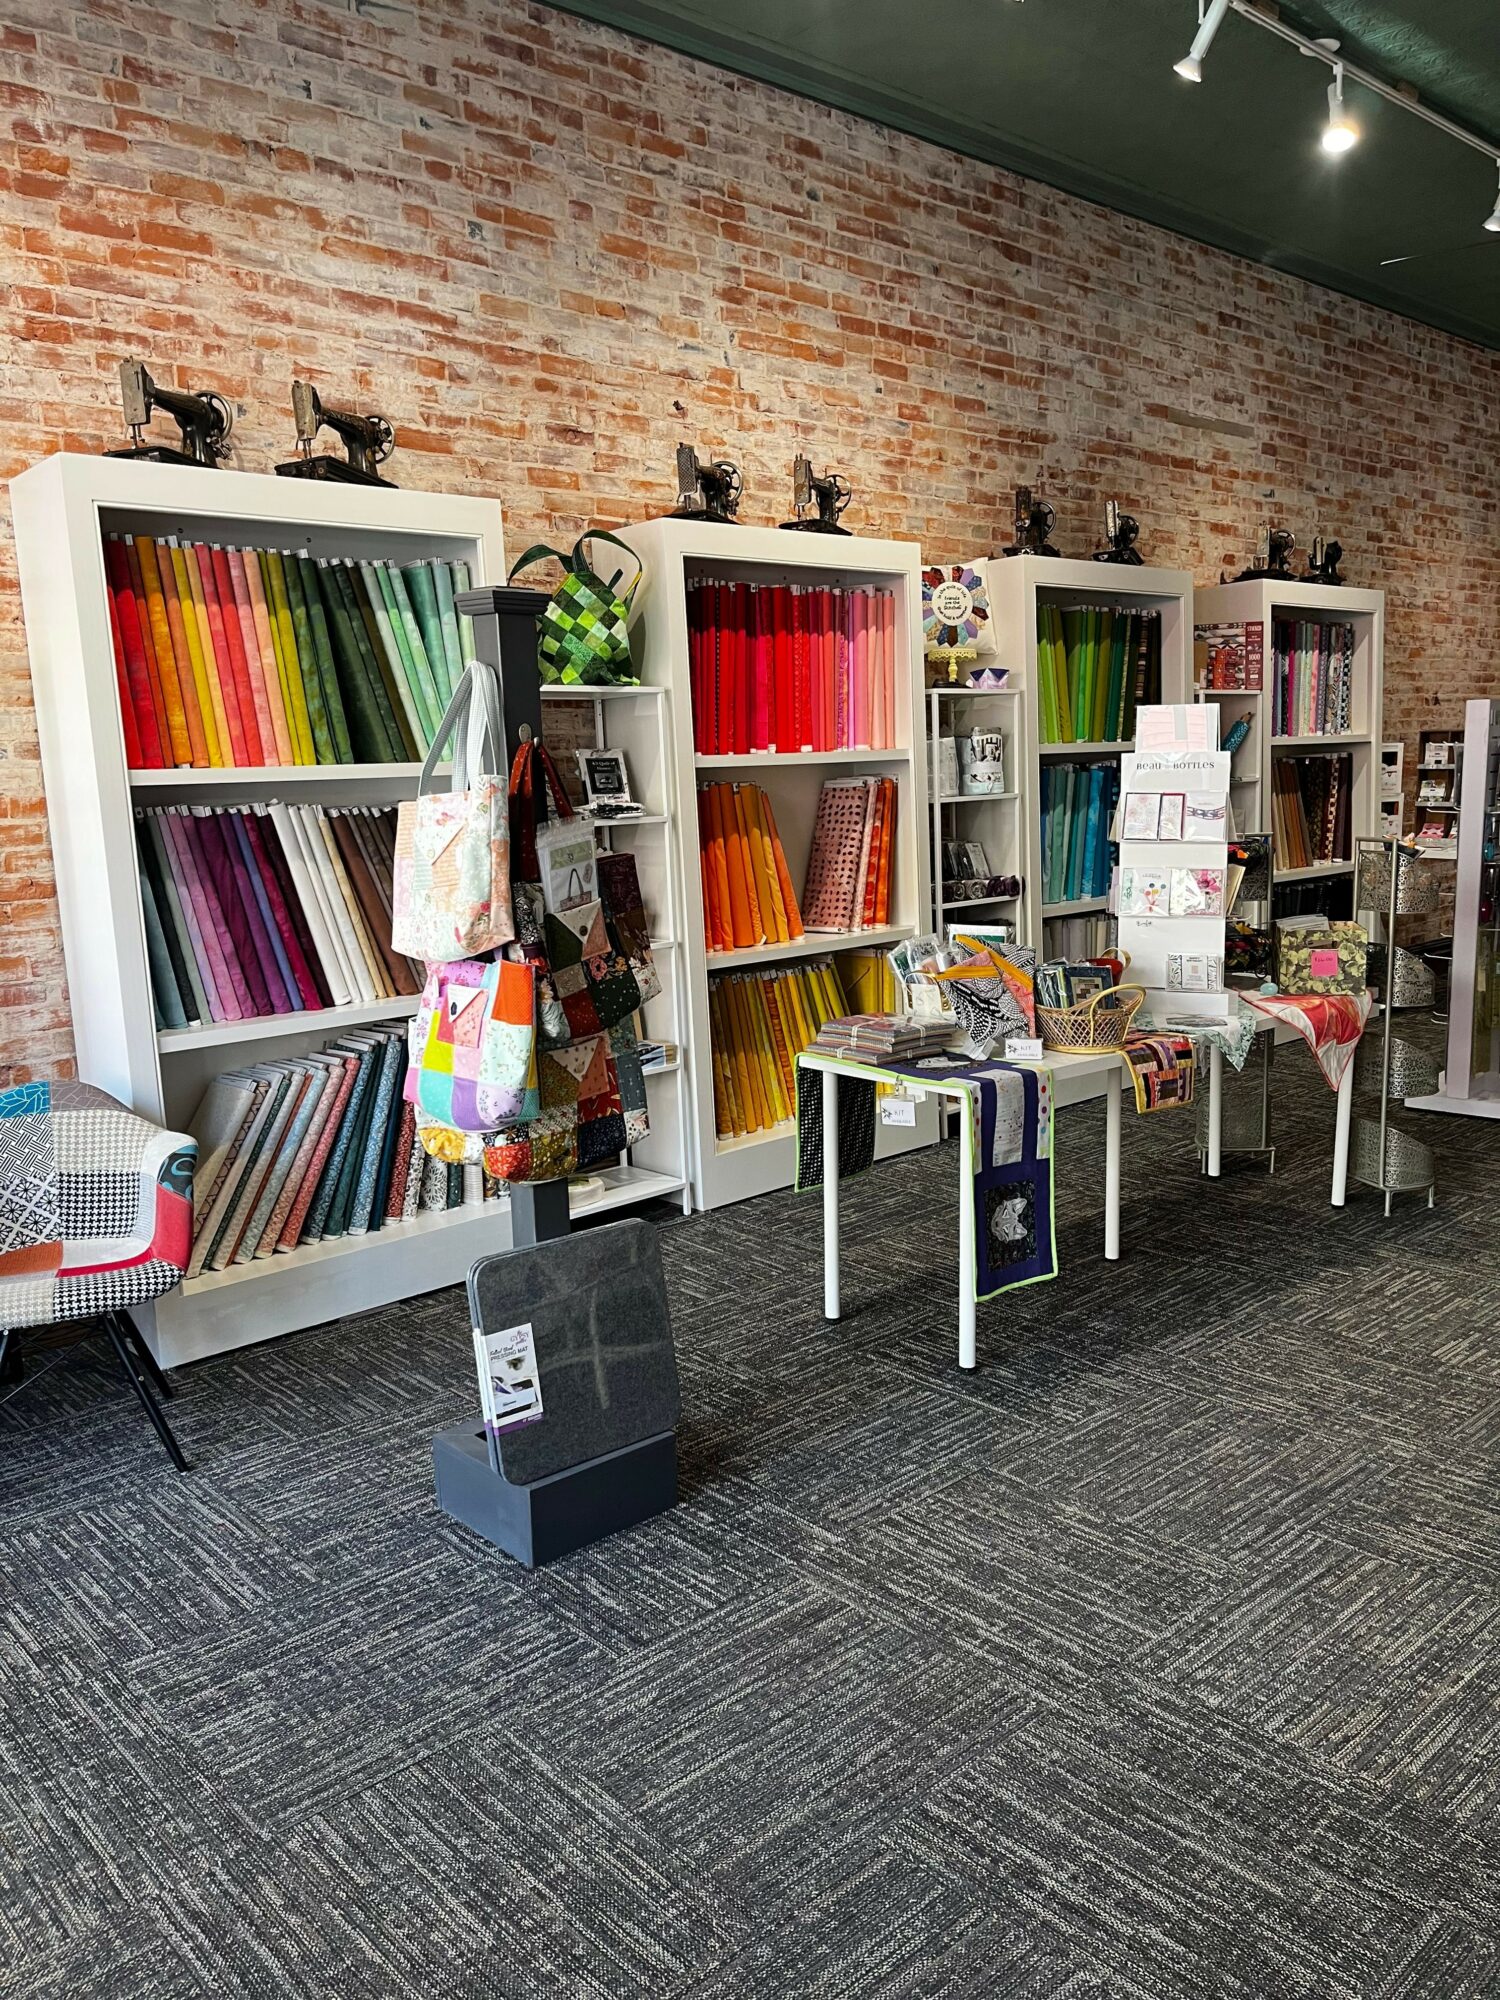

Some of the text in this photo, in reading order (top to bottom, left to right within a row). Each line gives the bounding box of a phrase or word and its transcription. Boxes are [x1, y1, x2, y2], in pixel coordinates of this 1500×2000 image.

[894, 1109, 905, 1117] KIT
[490, 1345, 529, 1361] PRESSING MAT
